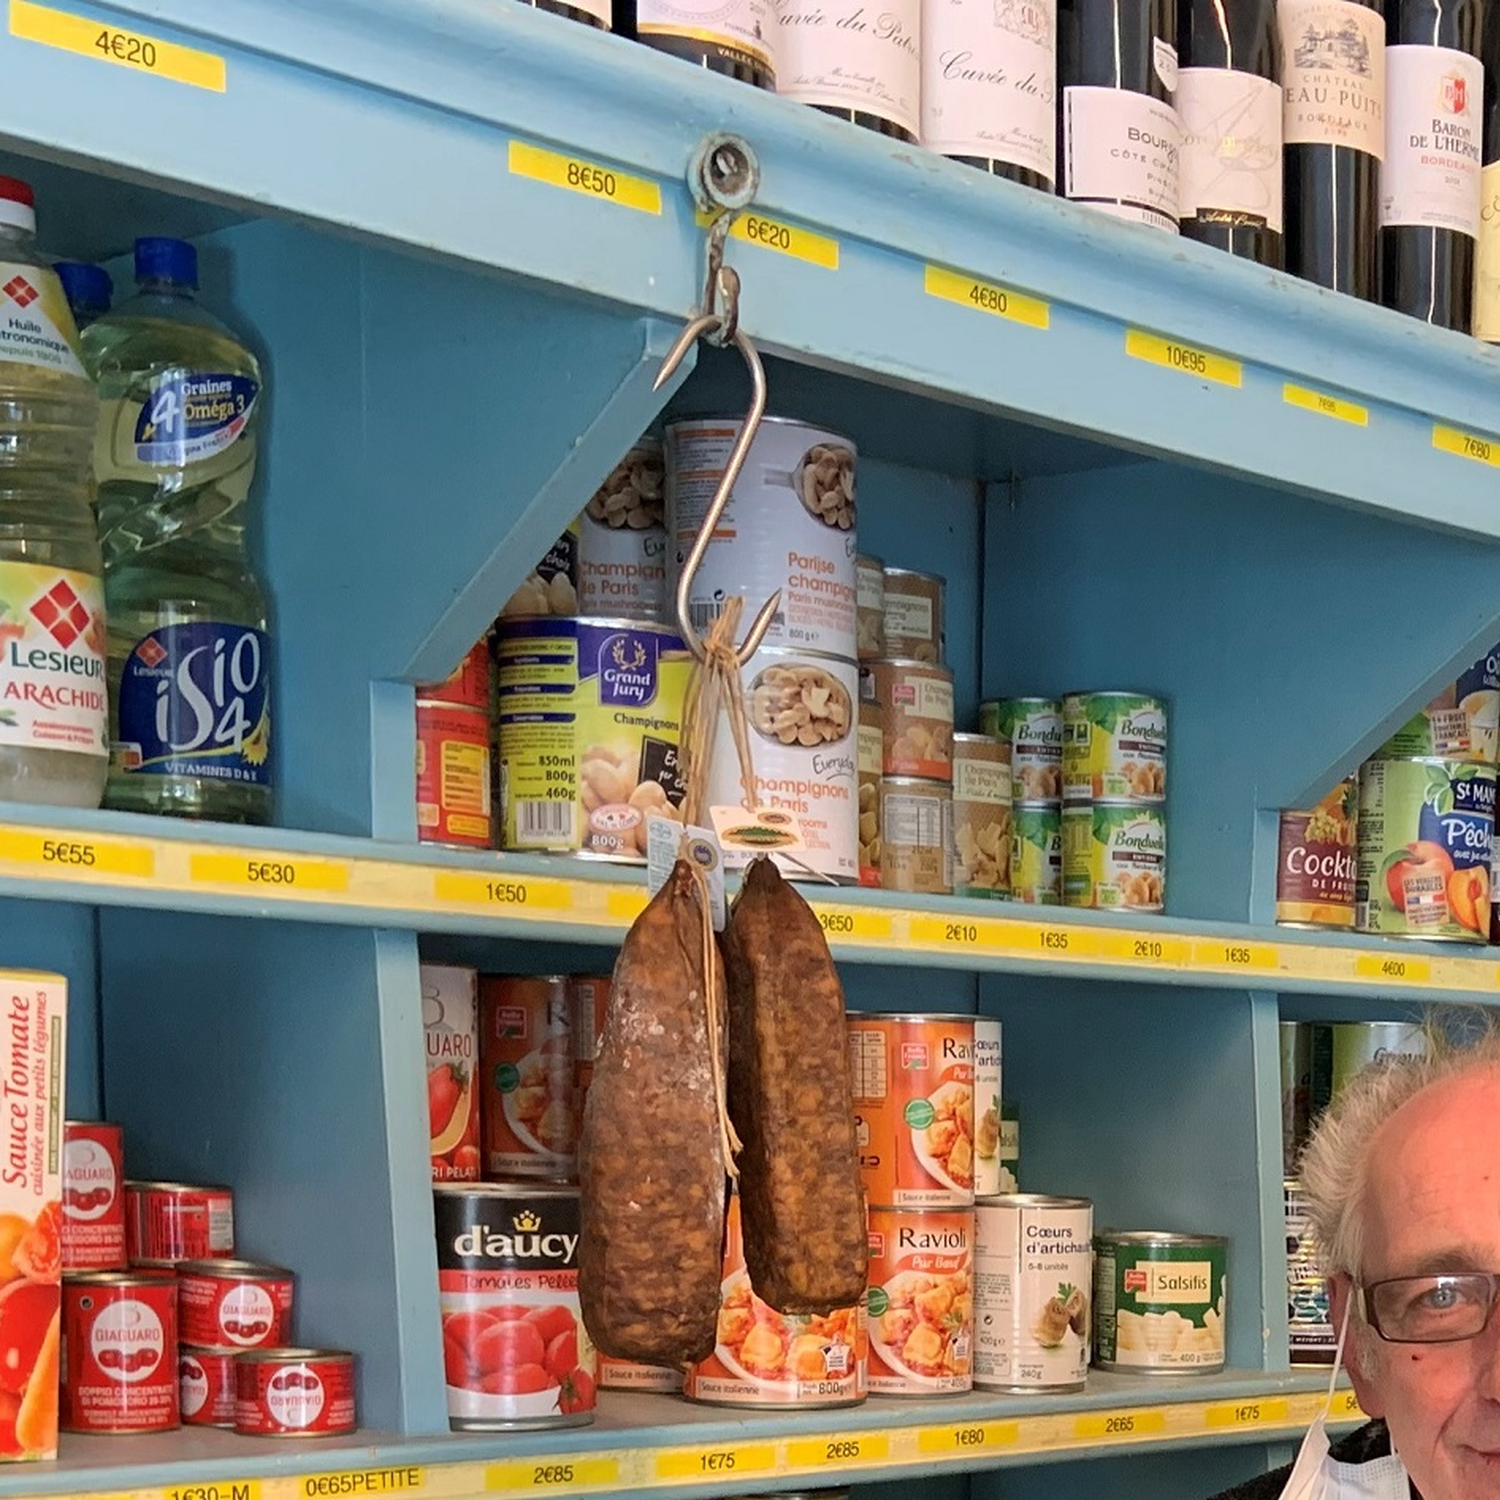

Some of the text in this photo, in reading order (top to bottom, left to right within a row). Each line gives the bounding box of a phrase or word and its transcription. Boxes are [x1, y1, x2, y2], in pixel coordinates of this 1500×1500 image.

[837, 14, 867, 33] du
[96, 32, 157, 67] 4€20
[939, 50, 1038, 97] Cuvée du
[1432, 119, 1471, 139] BARON
[1410, 135, 1428, 148] DE
[567, 163, 616, 195] 8€50
[747, 218, 790, 249] 6€20
[970, 285, 1007, 313] 4€80
[1166, 346, 1206, 372] 10€95
[181, 380, 232, 396] Graines
[152, 390, 180, 433] 4
[184, 395, 245, 422] Oméga 3
[788, 552, 835, 574] Parijse
[602, 580, 638, 596] Paris
[604, 669, 650, 686] Grand
[613, 683, 644, 701] Jury
[215, 697, 250, 751] 4
[614, 713, 679, 731] Champignons
[165, 762, 231, 779] VITAMINES
[538, 756, 575, 767] 850ml
[546, 771, 575, 784] 800g
[546, 787, 576, 800] 460g
[1456, 782, 1470, 799] St
[592, 834, 624, 848] 800g
[42, 840, 95, 865] 5€55
[247, 862, 295, 884] 5€30
[485, 884, 526, 904] 1€50
[820, 913, 853, 932] 3€50
[946, 925, 977, 941] 2€10
[1040, 932, 1068, 948] 1€35
[1134, 941, 1162, 957] 2€10
[1225, 948, 1250, 963] 1€35
[426, 1032, 472, 1058] UARO
[3, 996, 30, 1188] Sauce Tomate
[32, 991, 49, 1196] cuisinée aux petits légumes
[899, 1227, 966, 1249] Ravioli
[1027, 1226, 1072, 1238] Cœurs
[453, 1226, 579, 1263] d'aucy
[912, 1255, 930, 1269] Pur
[1158, 1274, 1207, 1290] Salsifis
[702, 1383, 724, 1394] Sauce
[1235, 1406, 1260, 1421] 1€75
[1106, 1417, 1134, 1434] 2€65
[955, 1429, 985, 1446] 1€80
[826, 1441, 860, 1459] 2€85
[700, 1452, 736, 1470] 1€75
[306, 1468, 421, 1498] 0€65PETITE
[533, 1466, 574, 1484] 2€85
